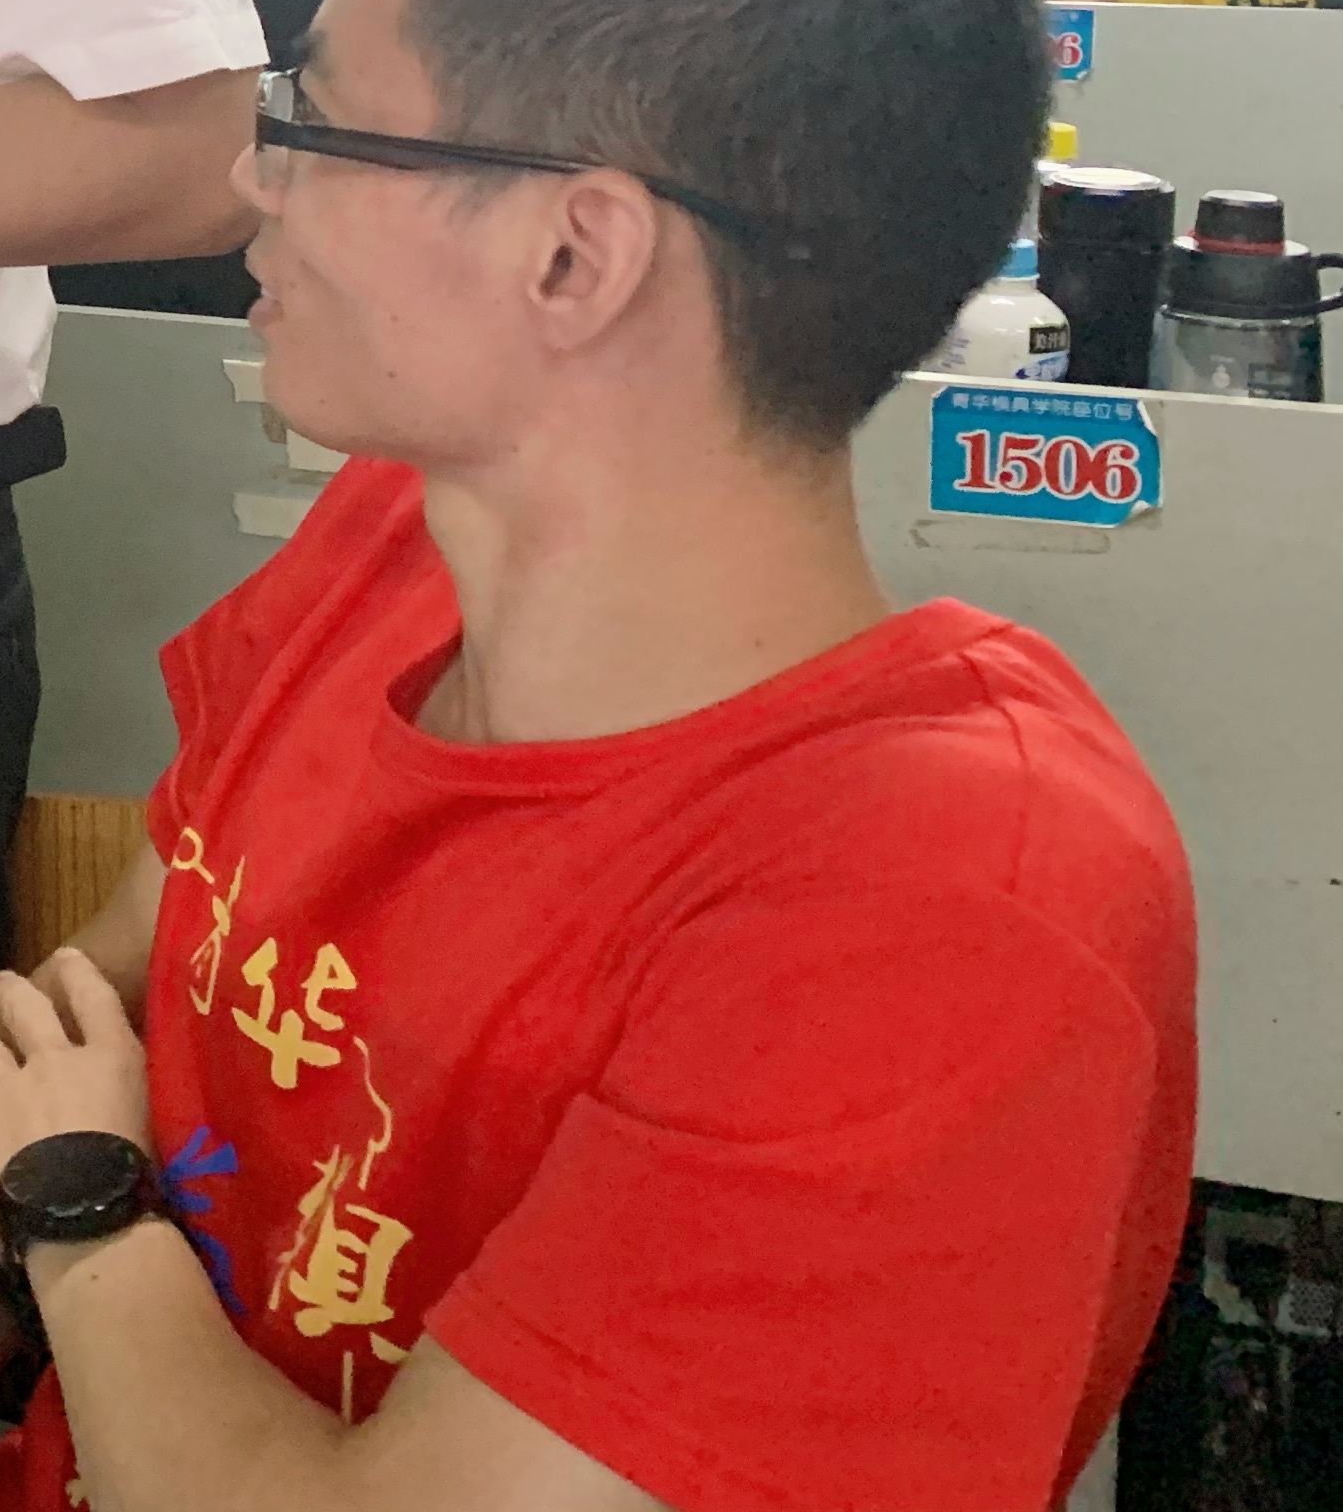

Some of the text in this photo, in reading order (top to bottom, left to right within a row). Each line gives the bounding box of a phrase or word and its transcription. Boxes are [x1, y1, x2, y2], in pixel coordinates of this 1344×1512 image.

[951, 392, 1134, 422] 青华模具学院座位号
[953, 429, 1142, 504] 1506
